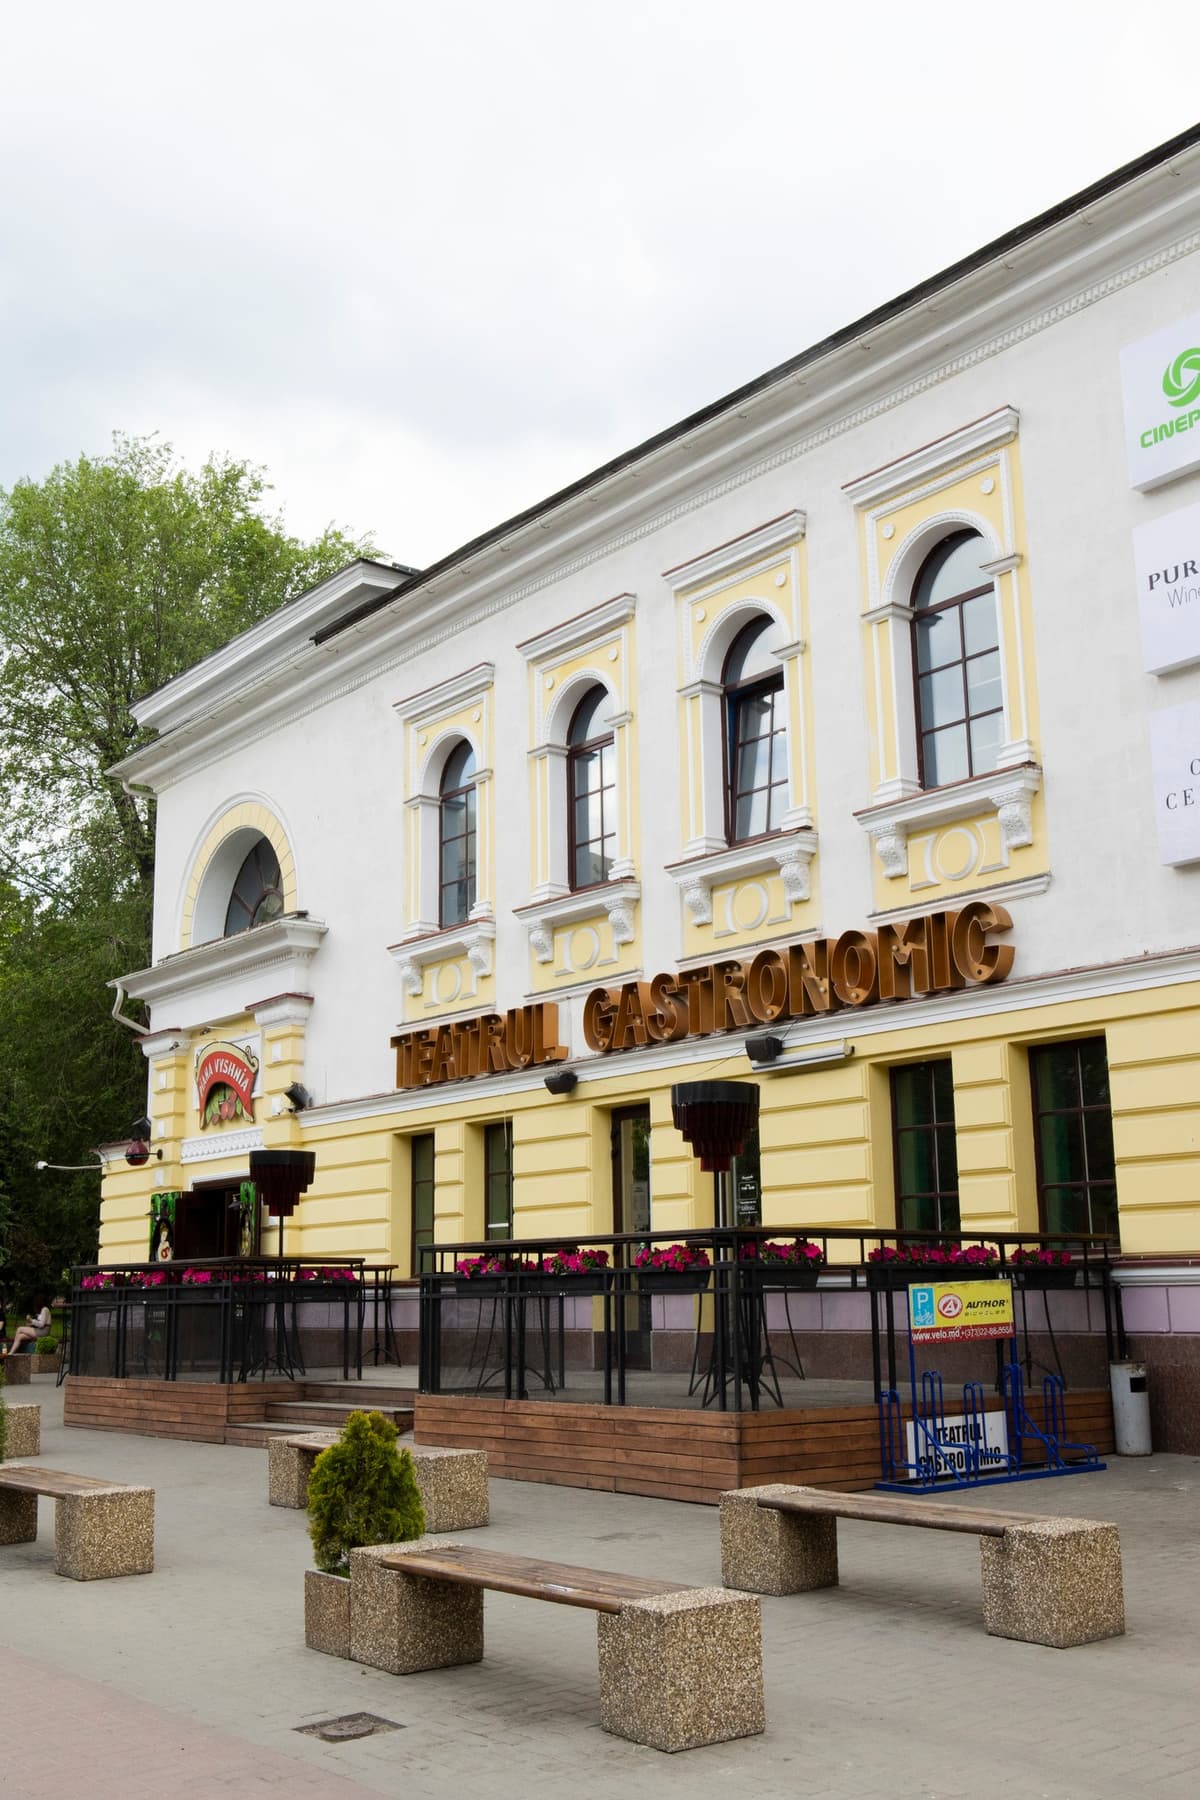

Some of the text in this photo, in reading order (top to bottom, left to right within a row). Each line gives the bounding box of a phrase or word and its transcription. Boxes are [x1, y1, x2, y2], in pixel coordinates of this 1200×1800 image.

[1148, 559, 1199, 591] PUR
[1167, 585, 1200, 609] Win
[391, 901, 1016, 1089] TEATRUL GASTRONOMIC
[917, 1292, 929, 1310] P
[966, 1299, 1006, 1309] AUTHOR
[912, 1329, 960, 1341] www.velo.md
